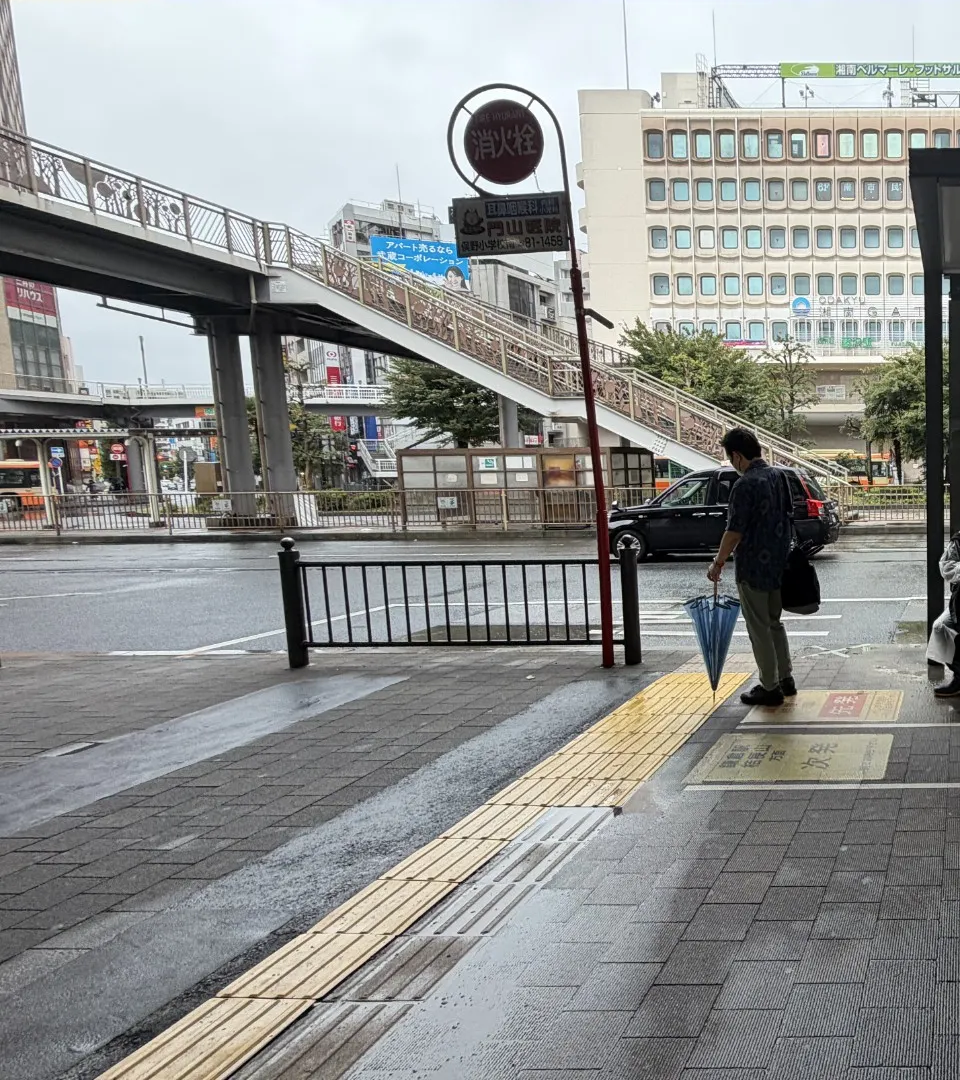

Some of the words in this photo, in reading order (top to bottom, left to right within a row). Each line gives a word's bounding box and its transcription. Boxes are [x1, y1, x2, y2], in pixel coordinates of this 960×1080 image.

[471, 123, 538, 161] 消火栓
[385, 241, 453, 255] アパート売るなら
[376, 250, 464, 266] 武蔵コーポレーション
[17, 286, 43, 303] リハウス
[818, 296, 867, 305] ODAKYU
[829, 695, 859, 716] 先発
[801, 742, 839, 770] 次発
